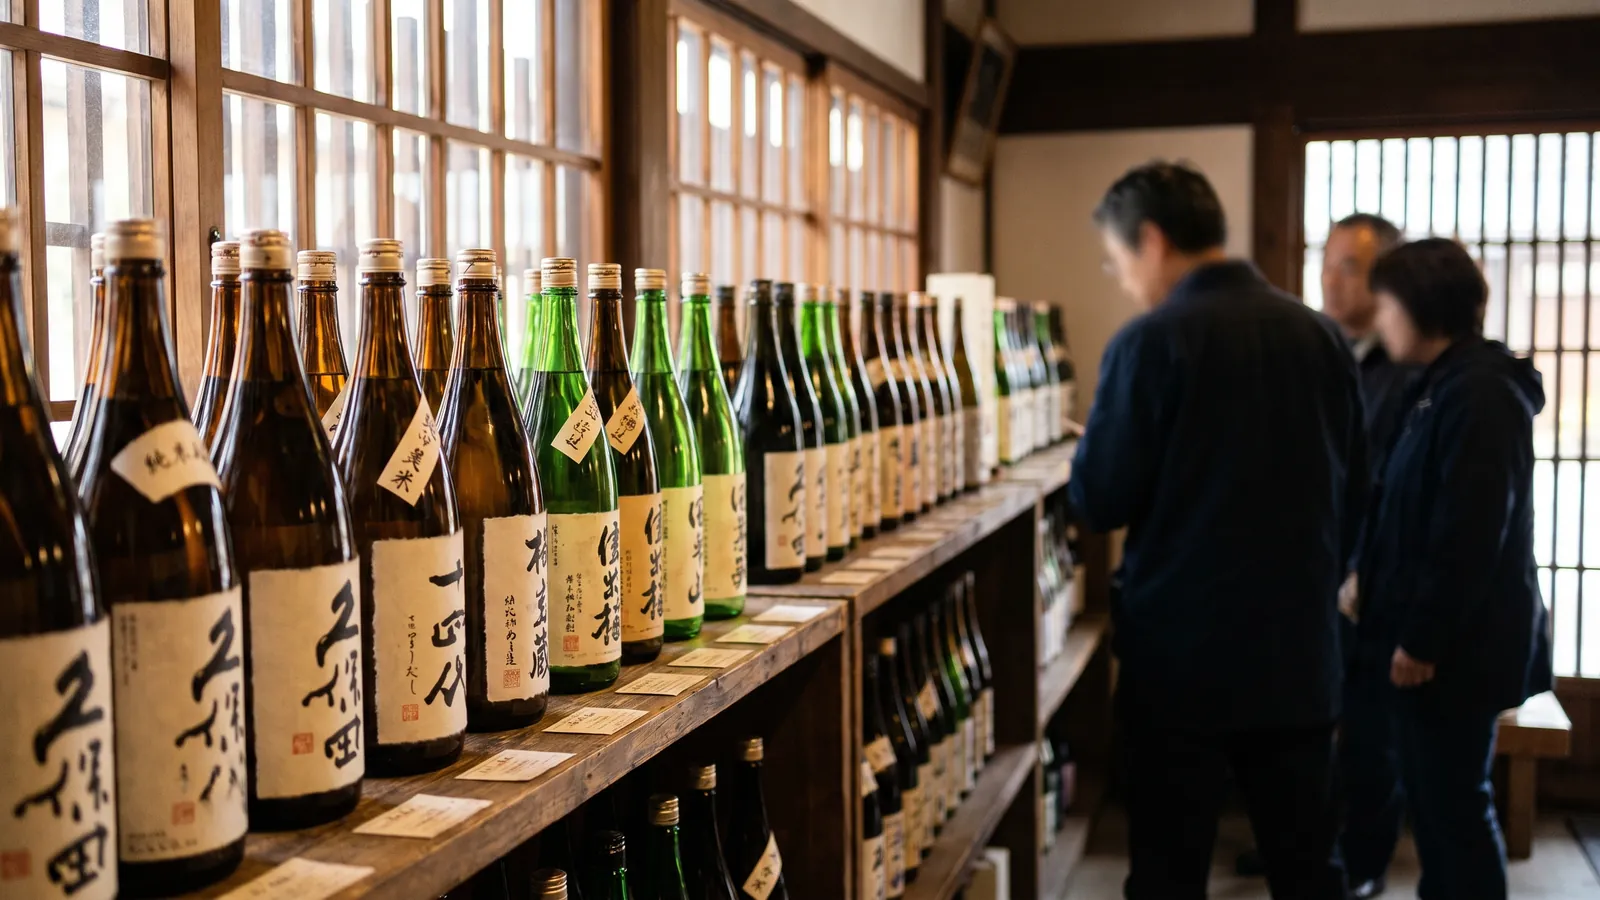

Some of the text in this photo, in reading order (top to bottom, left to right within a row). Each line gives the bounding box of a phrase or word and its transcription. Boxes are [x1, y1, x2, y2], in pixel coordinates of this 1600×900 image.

[13, 649, 109, 896] 久保田
[301, 579, 362, 769] 久保田
